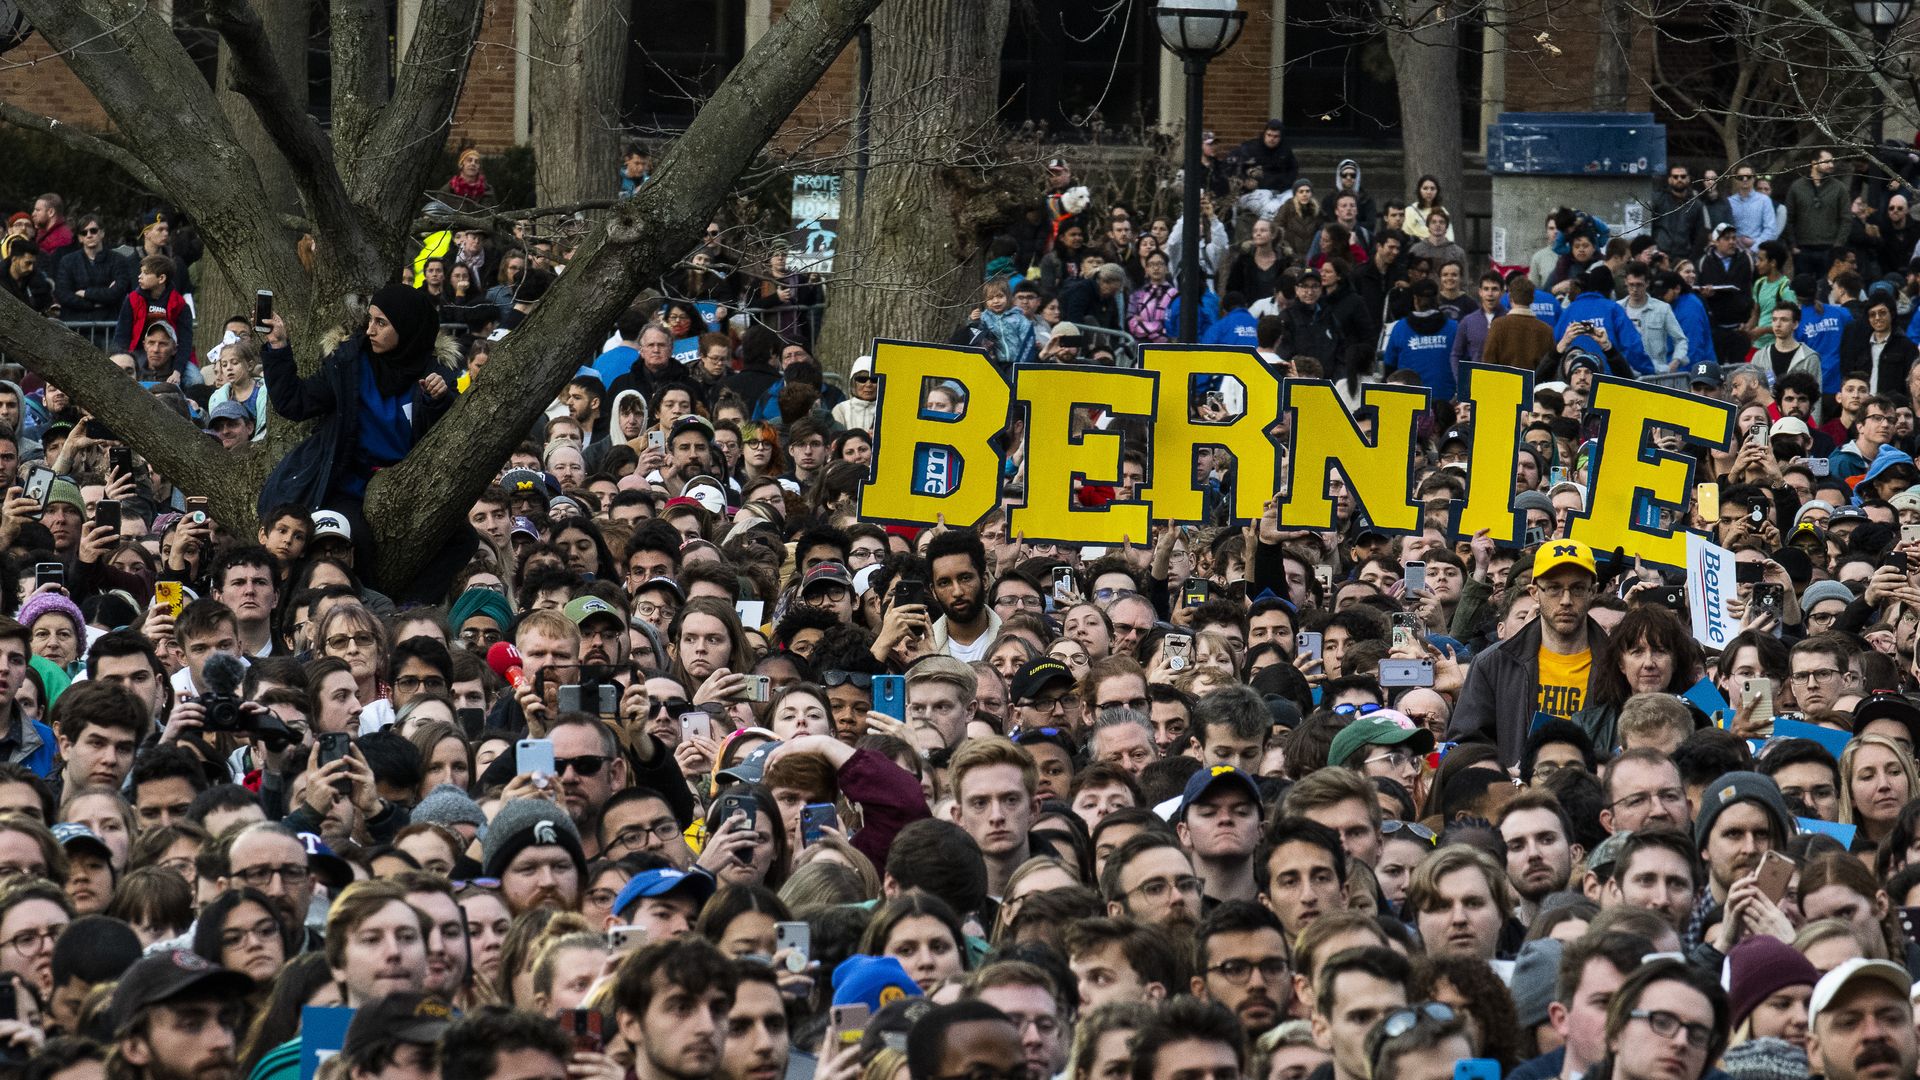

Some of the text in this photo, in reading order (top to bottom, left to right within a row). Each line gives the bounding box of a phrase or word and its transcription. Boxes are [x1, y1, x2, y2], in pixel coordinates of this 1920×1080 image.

[1417, 335, 1447, 346] LIBERTY
[858, 337, 1738, 569] BERNIE
[1553, 544, 1578, 558] M
[1704, 547, 1727, 643] Bernie
[296, 831, 322, 855] T
